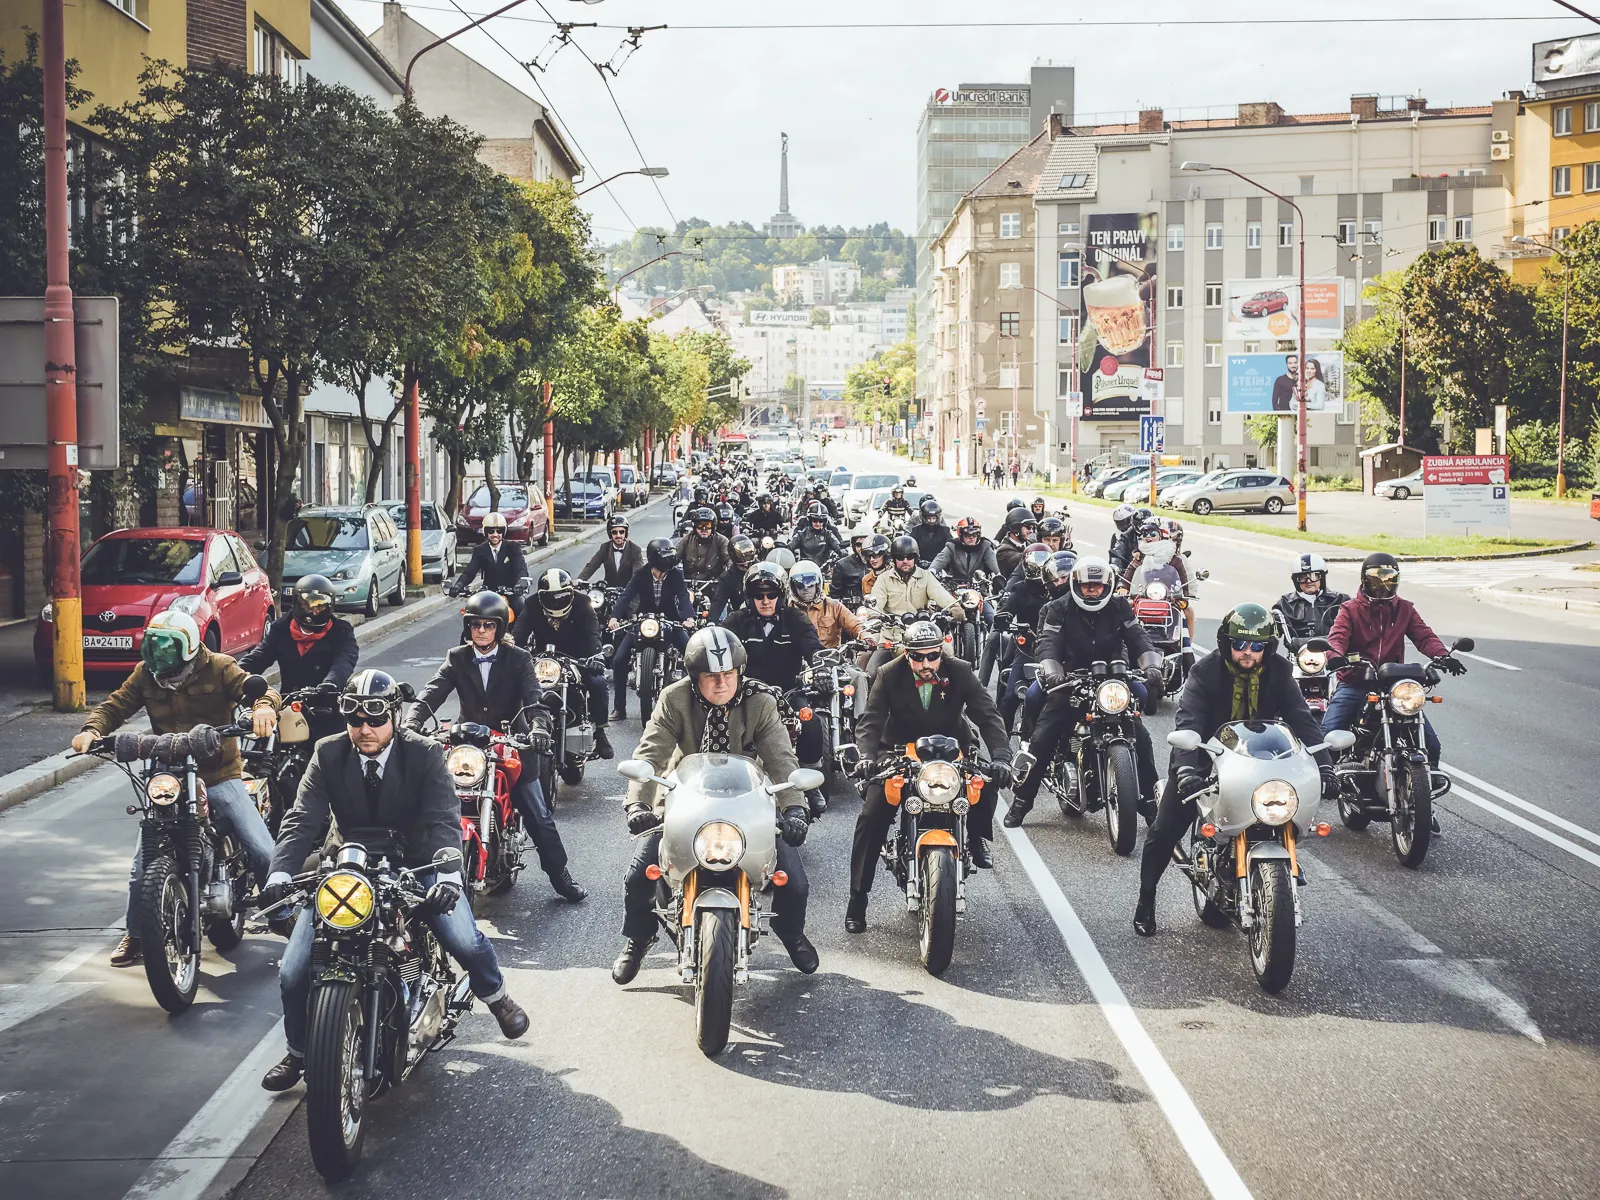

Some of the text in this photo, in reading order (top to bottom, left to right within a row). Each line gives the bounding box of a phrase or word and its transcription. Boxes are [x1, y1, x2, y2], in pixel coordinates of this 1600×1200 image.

[952, 91, 1025, 102] UniCredit Bank
[1090, 230, 1111, 245] TEN
[1095, 245, 1143, 262] ORIGINÁL
[770, 314, 808, 322] HYUNDAI
[1095, 375, 1118, 393] Pilsner
[1427, 457, 1505, 466] ZUBNÁ AMBULANCIA
[1495, 488, 1503, 498] P
